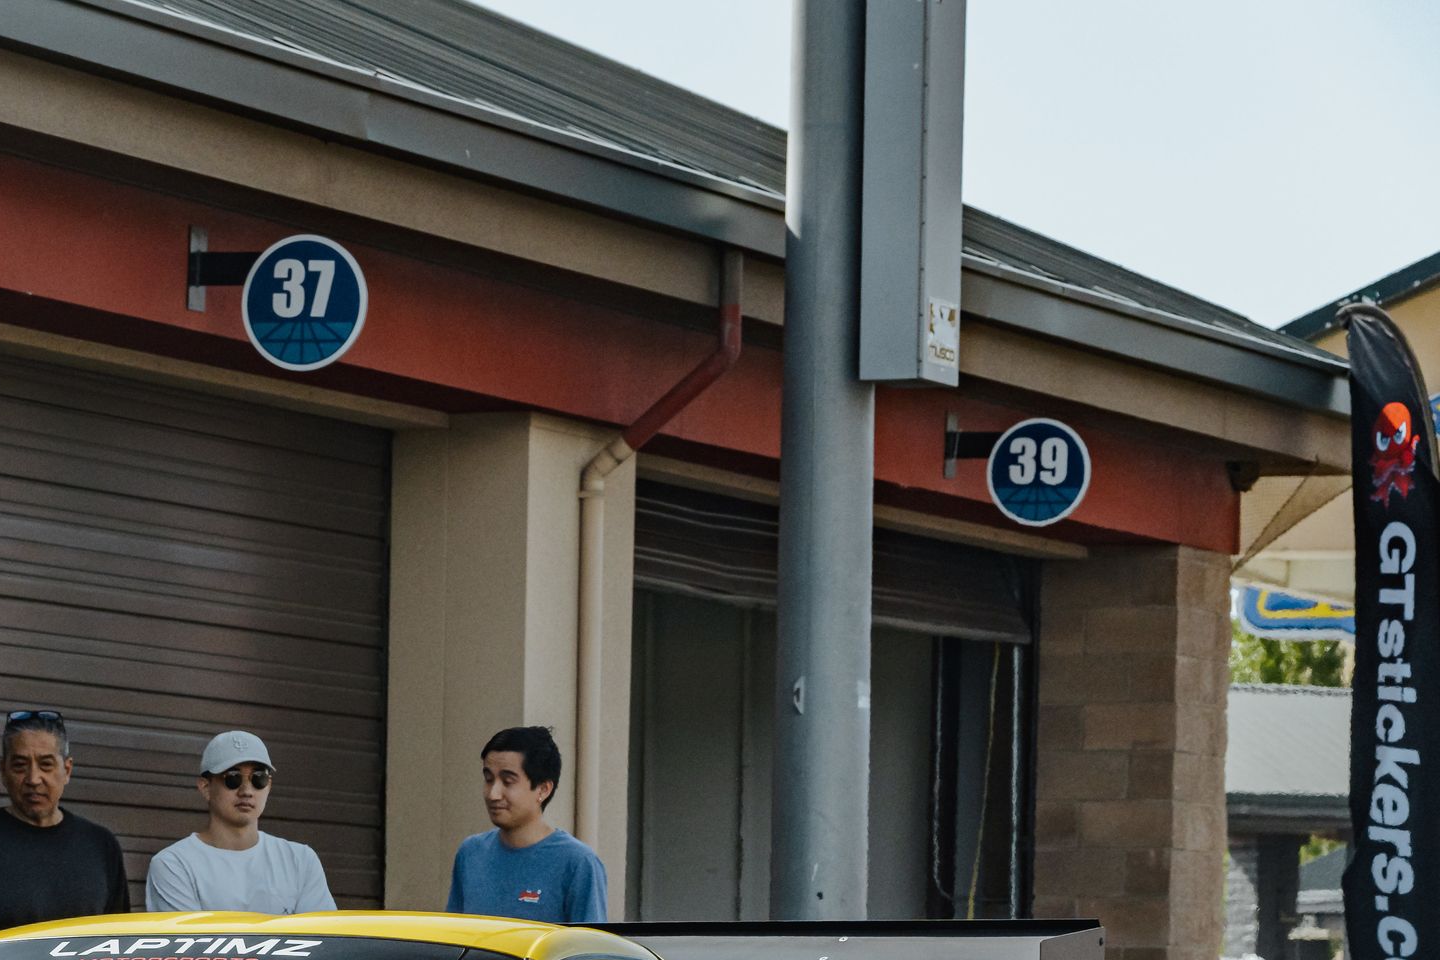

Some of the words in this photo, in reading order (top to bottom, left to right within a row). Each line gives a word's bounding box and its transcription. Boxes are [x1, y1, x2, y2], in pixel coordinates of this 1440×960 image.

[272, 258, 335, 318] 37
[1008, 437, 1068, 485] 39
[48, 937, 323, 957] LAPTIMZ
